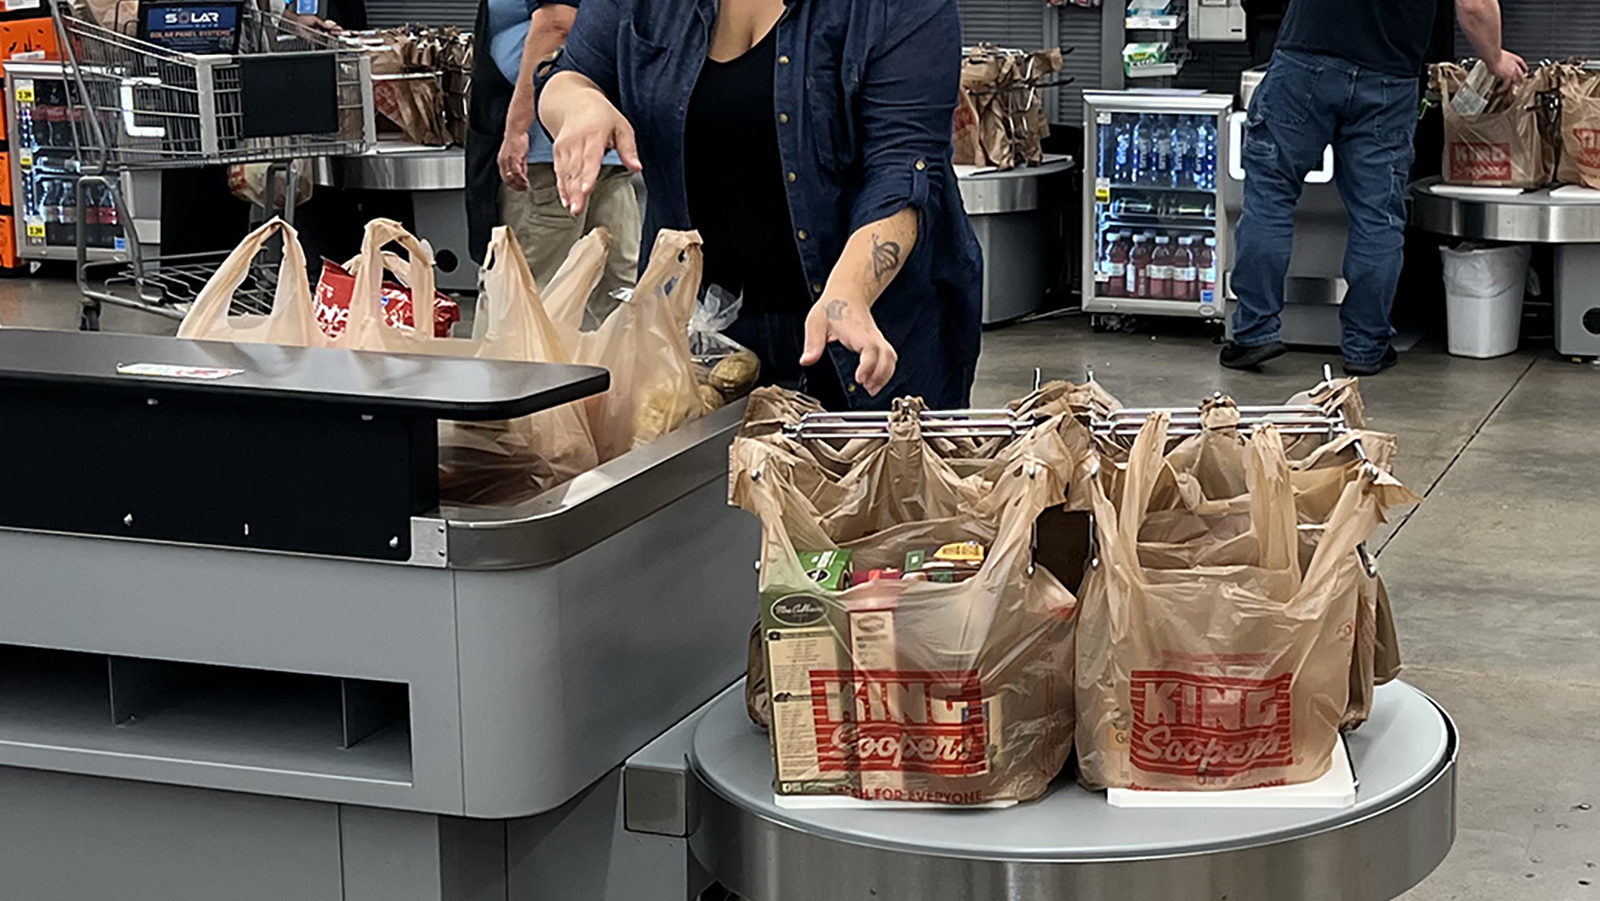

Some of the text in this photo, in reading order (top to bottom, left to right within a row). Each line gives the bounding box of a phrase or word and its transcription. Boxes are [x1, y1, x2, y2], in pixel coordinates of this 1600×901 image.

[165, 12, 219, 24] SOLAR
[825, 681, 969, 724] KING
[1144, 682, 1278, 730] KING
[1137, 725, 1281, 773] Soopers
[874, 787, 903, 800] FOR
